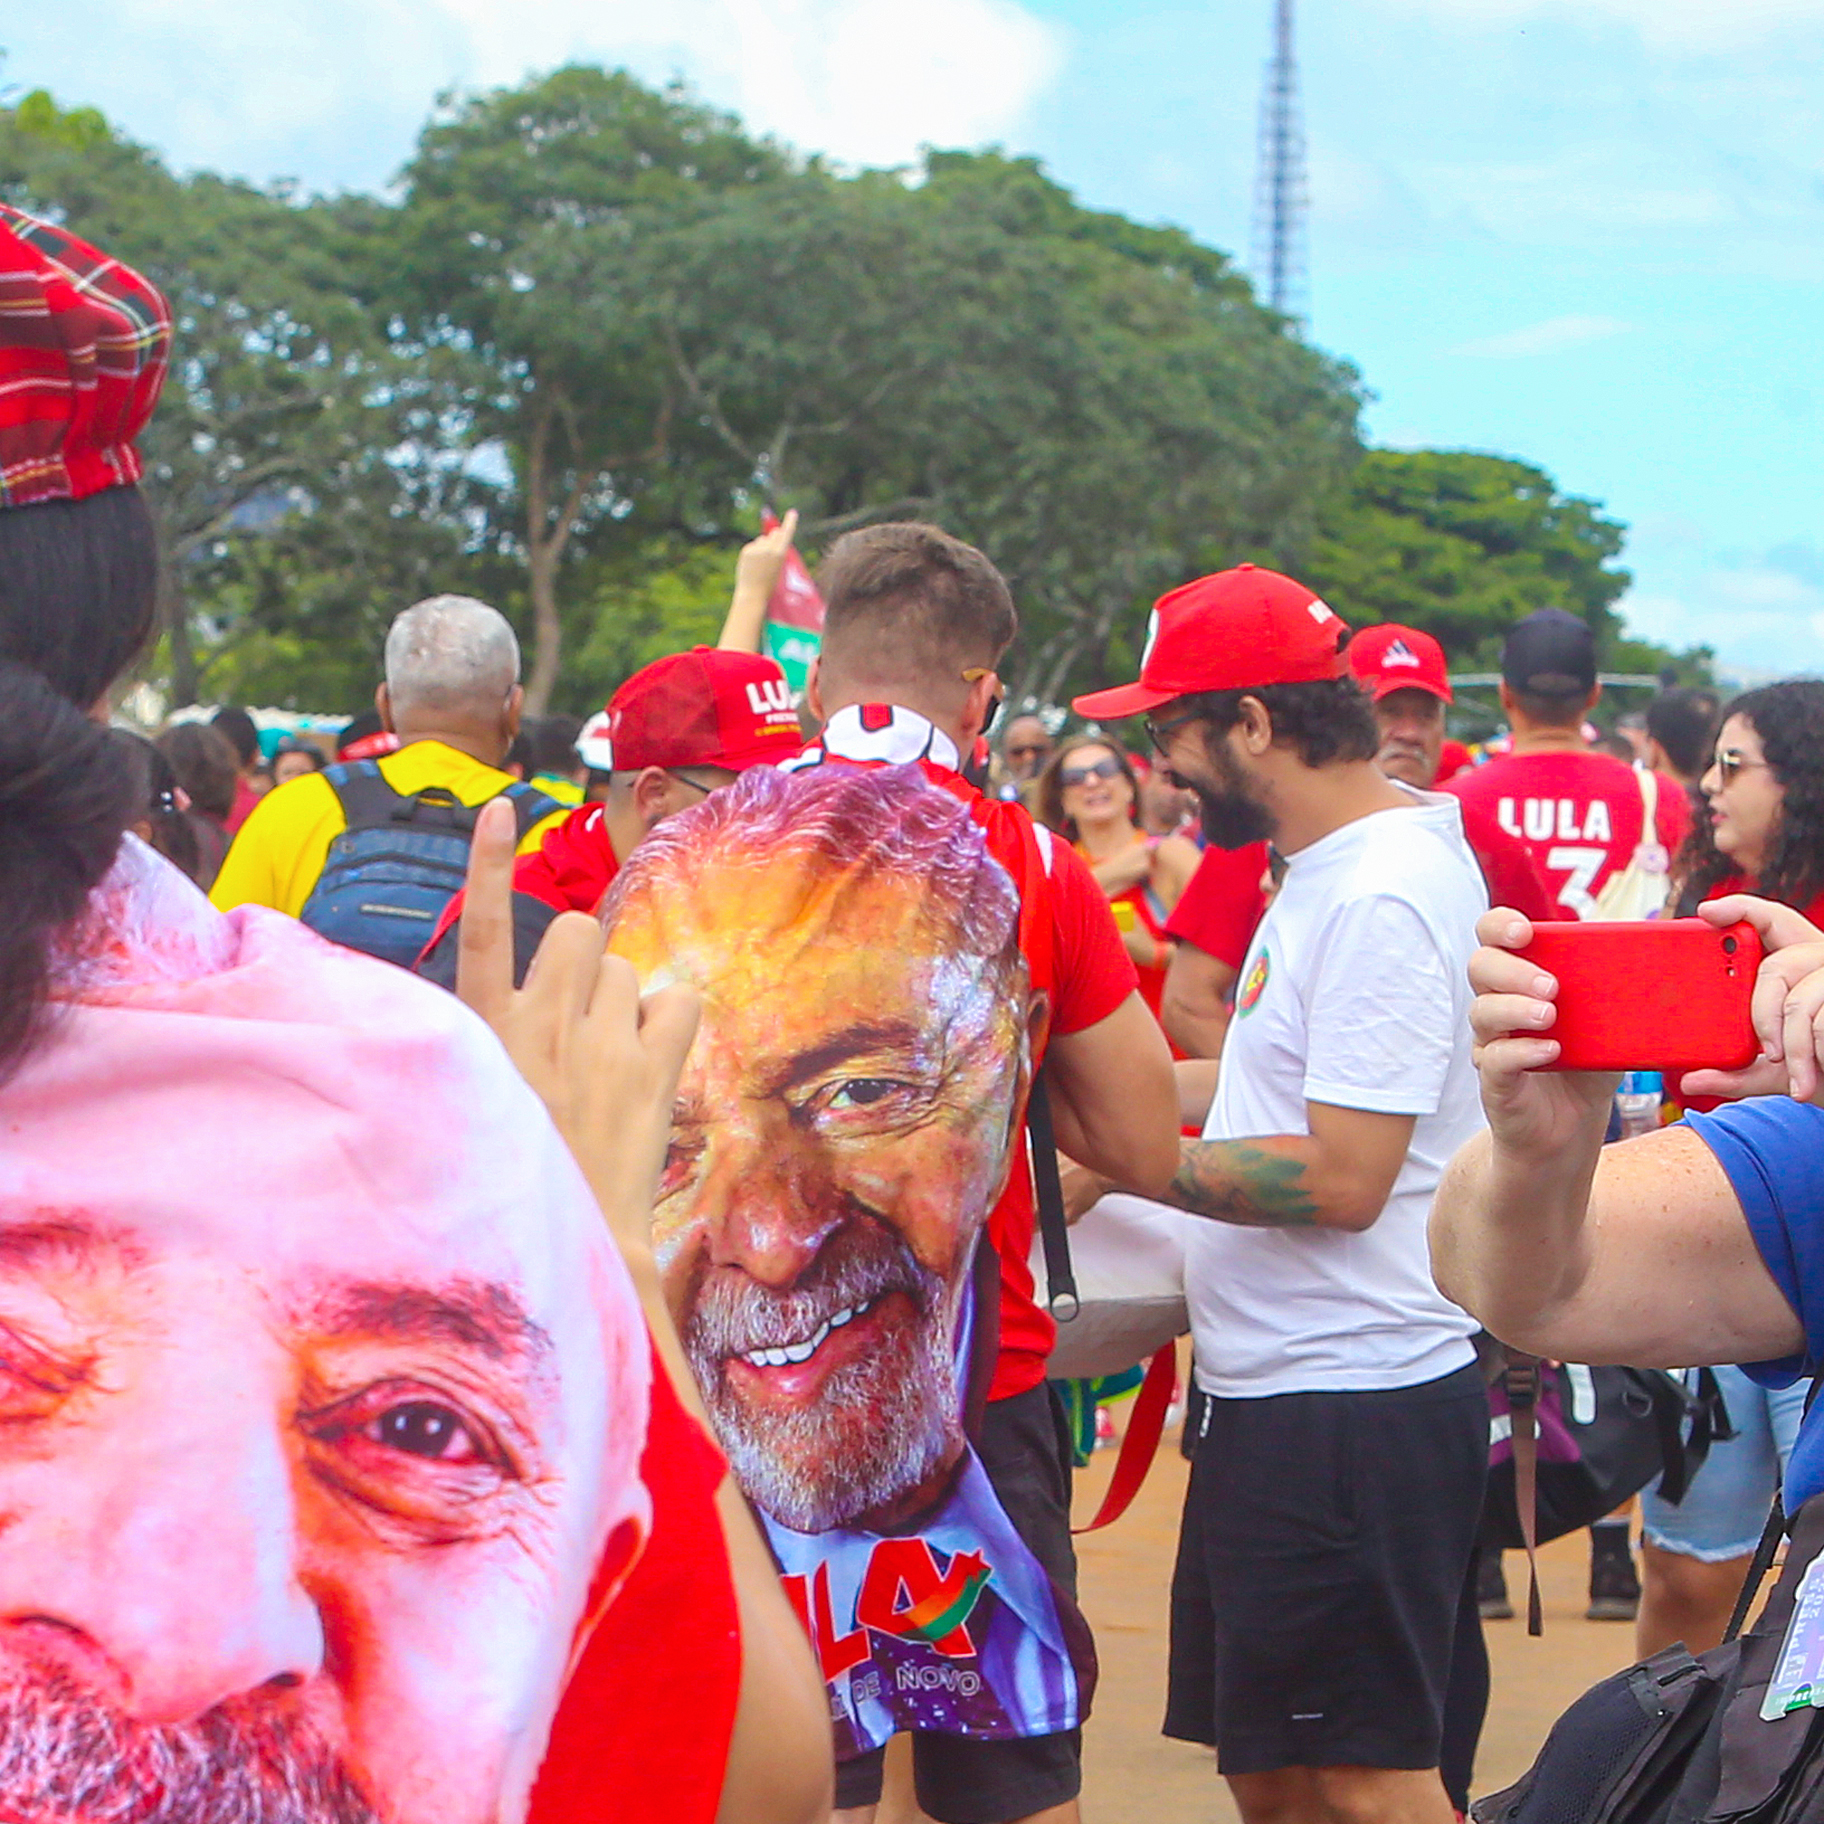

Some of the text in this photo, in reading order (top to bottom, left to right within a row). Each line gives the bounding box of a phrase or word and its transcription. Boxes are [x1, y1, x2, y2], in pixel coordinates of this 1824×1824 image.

[1497, 796, 1612, 842] LULA
[851, 1659, 981, 1704] DE NOVO
